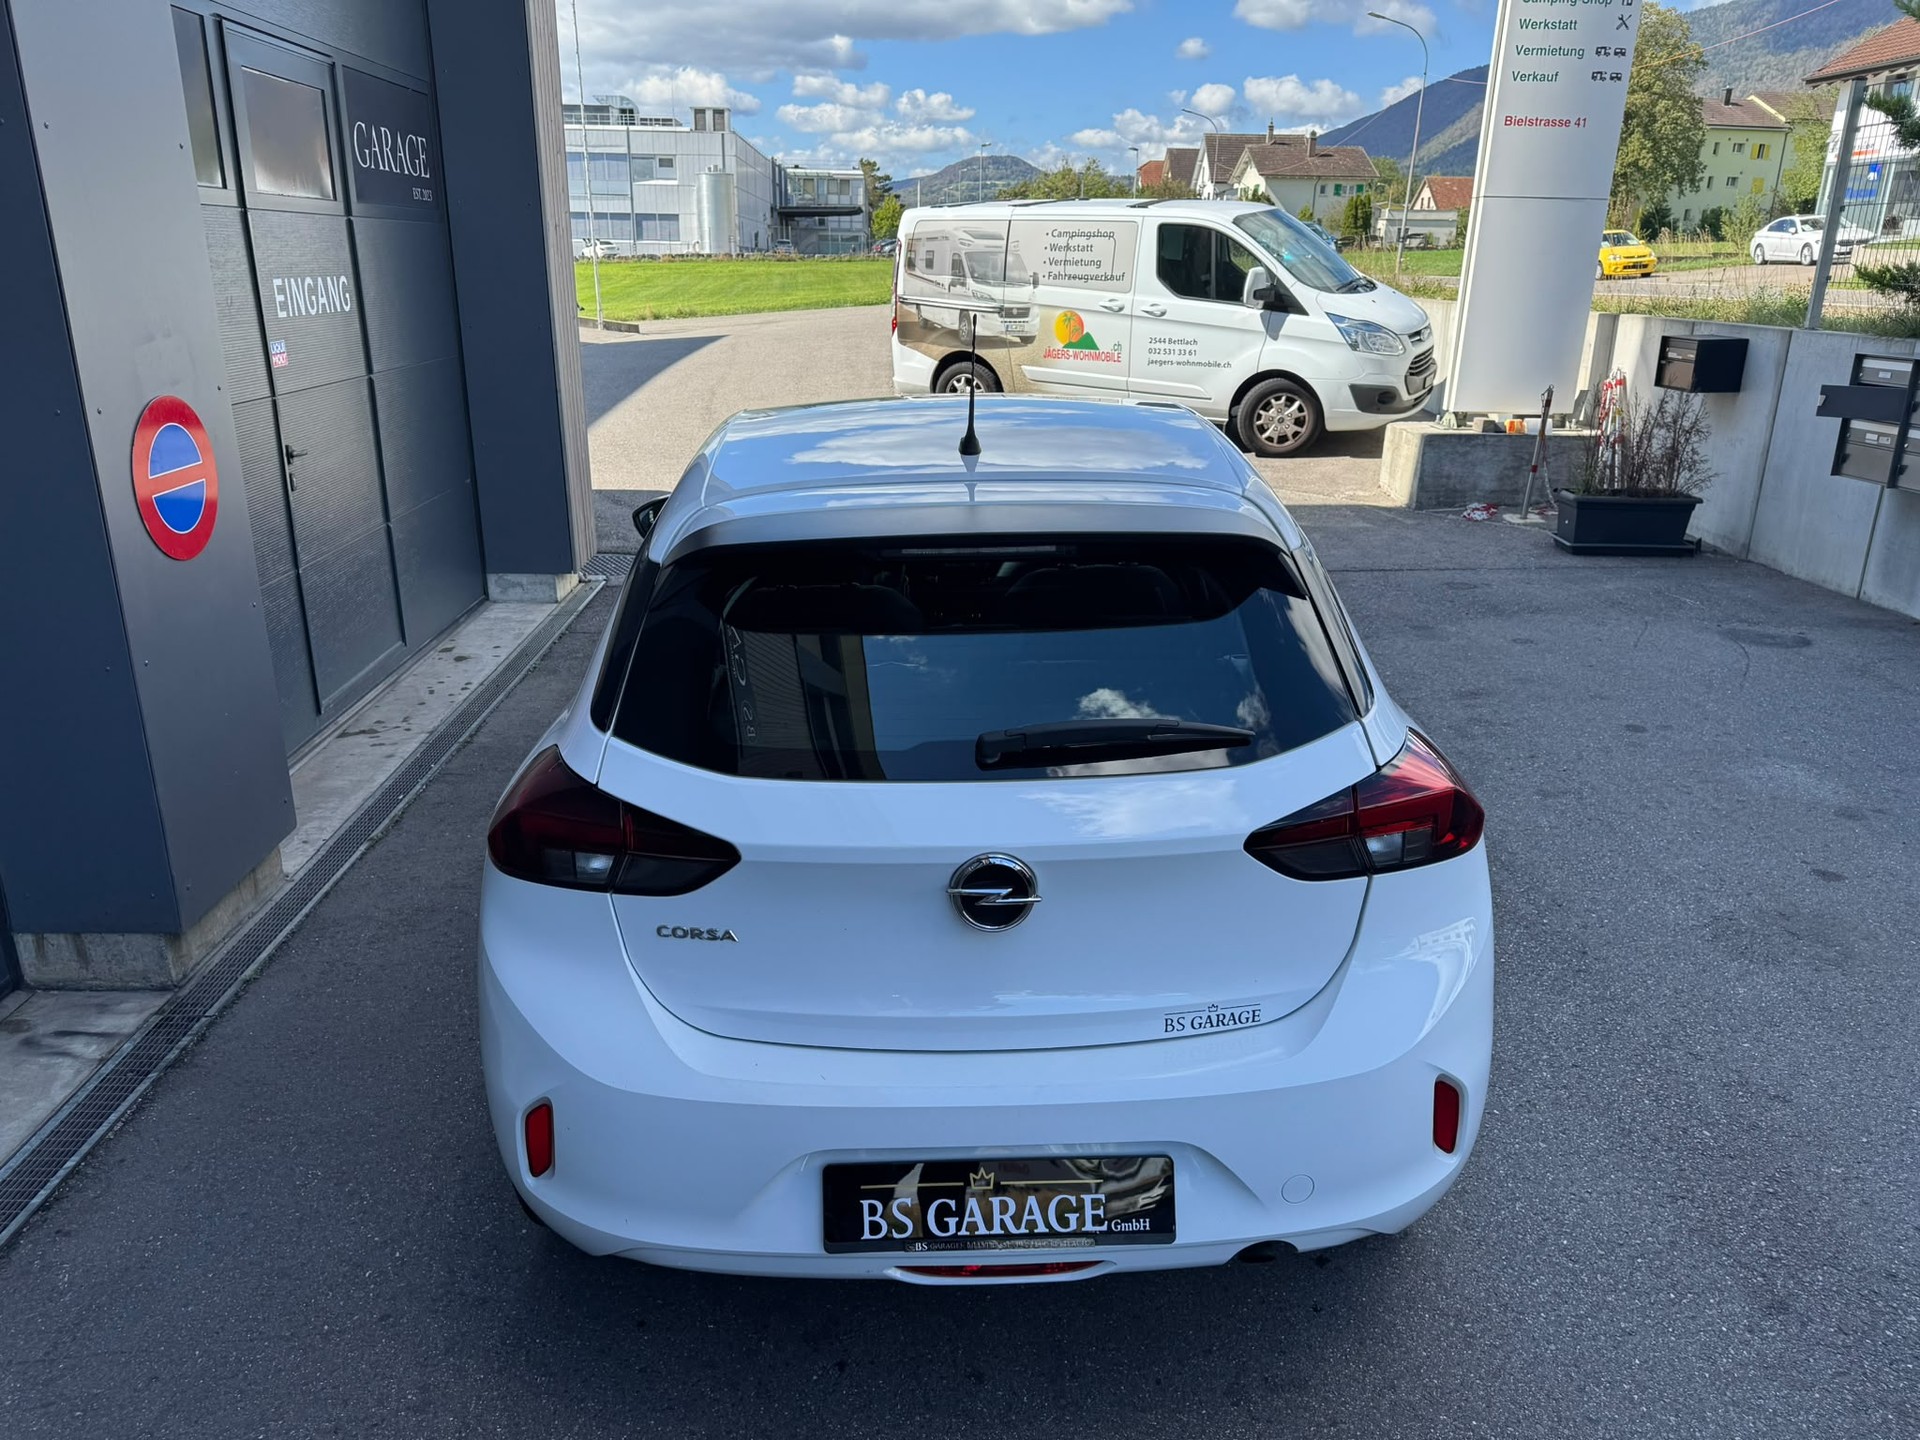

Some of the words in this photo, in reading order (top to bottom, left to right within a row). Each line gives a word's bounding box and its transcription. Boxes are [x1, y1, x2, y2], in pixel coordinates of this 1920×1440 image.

[1519, 18, 1577, 30] Werkstatt
[1515, 44, 1585, 59] Vermietung
[1512, 70, 1559, 82] Verkauf
[1504, 115, 1571, 127] Bielstrasse
[1574, 117, 1587, 128] 41
[354, 121, 430, 178] GARAGE
[1051, 229, 1115, 240] Campingshop
[1049, 243, 1093, 252] Werkstatt
[1048, 257, 1102, 269] Vermietung
[1047, 271, 1125, 283] Fahrzeugverkauf
[273, 275, 351, 318] EINGANG
[1148, 337, 1167, 345] 2544
[1168, 338, 1198, 346] Bettlach
[1043, 346, 1122, 363] JÄGERS-WOHNMOBILE
[1163, 348, 1176, 356] 531
[1147, 358, 1232, 369] jaegers-wohnmobile.ch
[656, 925, 739, 942] CORSA
[1164, 1016, 1185, 1033] BS
[1190, 1009, 1261, 1030] GARAGE
[860, 1197, 914, 1240] BS
[927, 1194, 1108, 1236] GARAGE
[1112, 1218, 1151, 1231] GmbH
